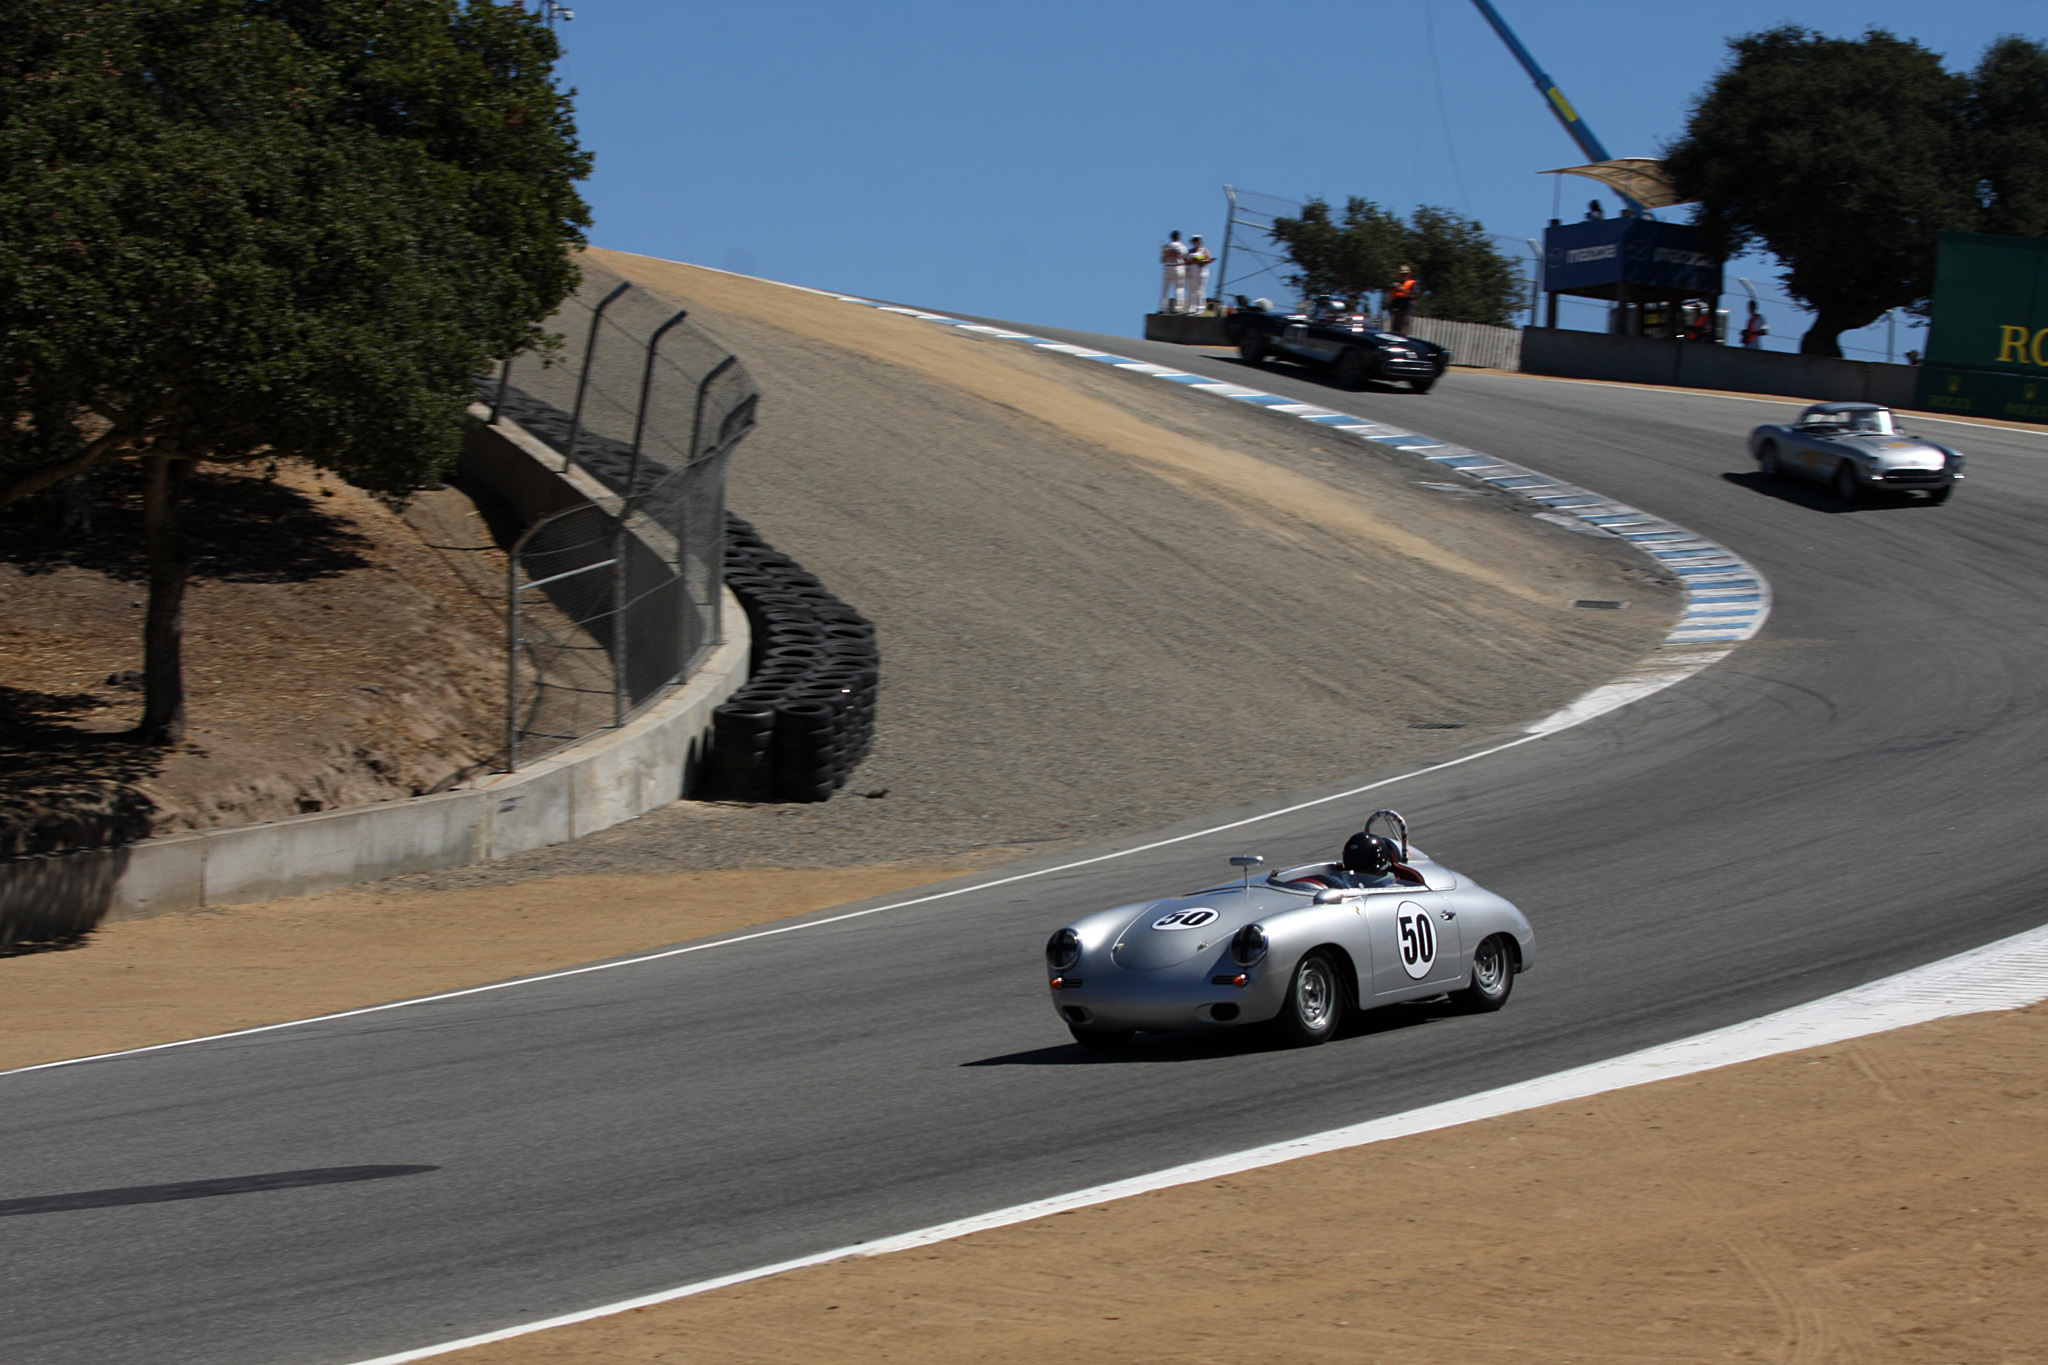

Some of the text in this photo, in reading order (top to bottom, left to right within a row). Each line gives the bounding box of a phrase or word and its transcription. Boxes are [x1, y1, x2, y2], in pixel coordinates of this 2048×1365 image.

[1929, 395, 1973, 409] ROLEX
[1157, 911, 1213, 926] 50
[1399, 914, 1433, 965] 50
